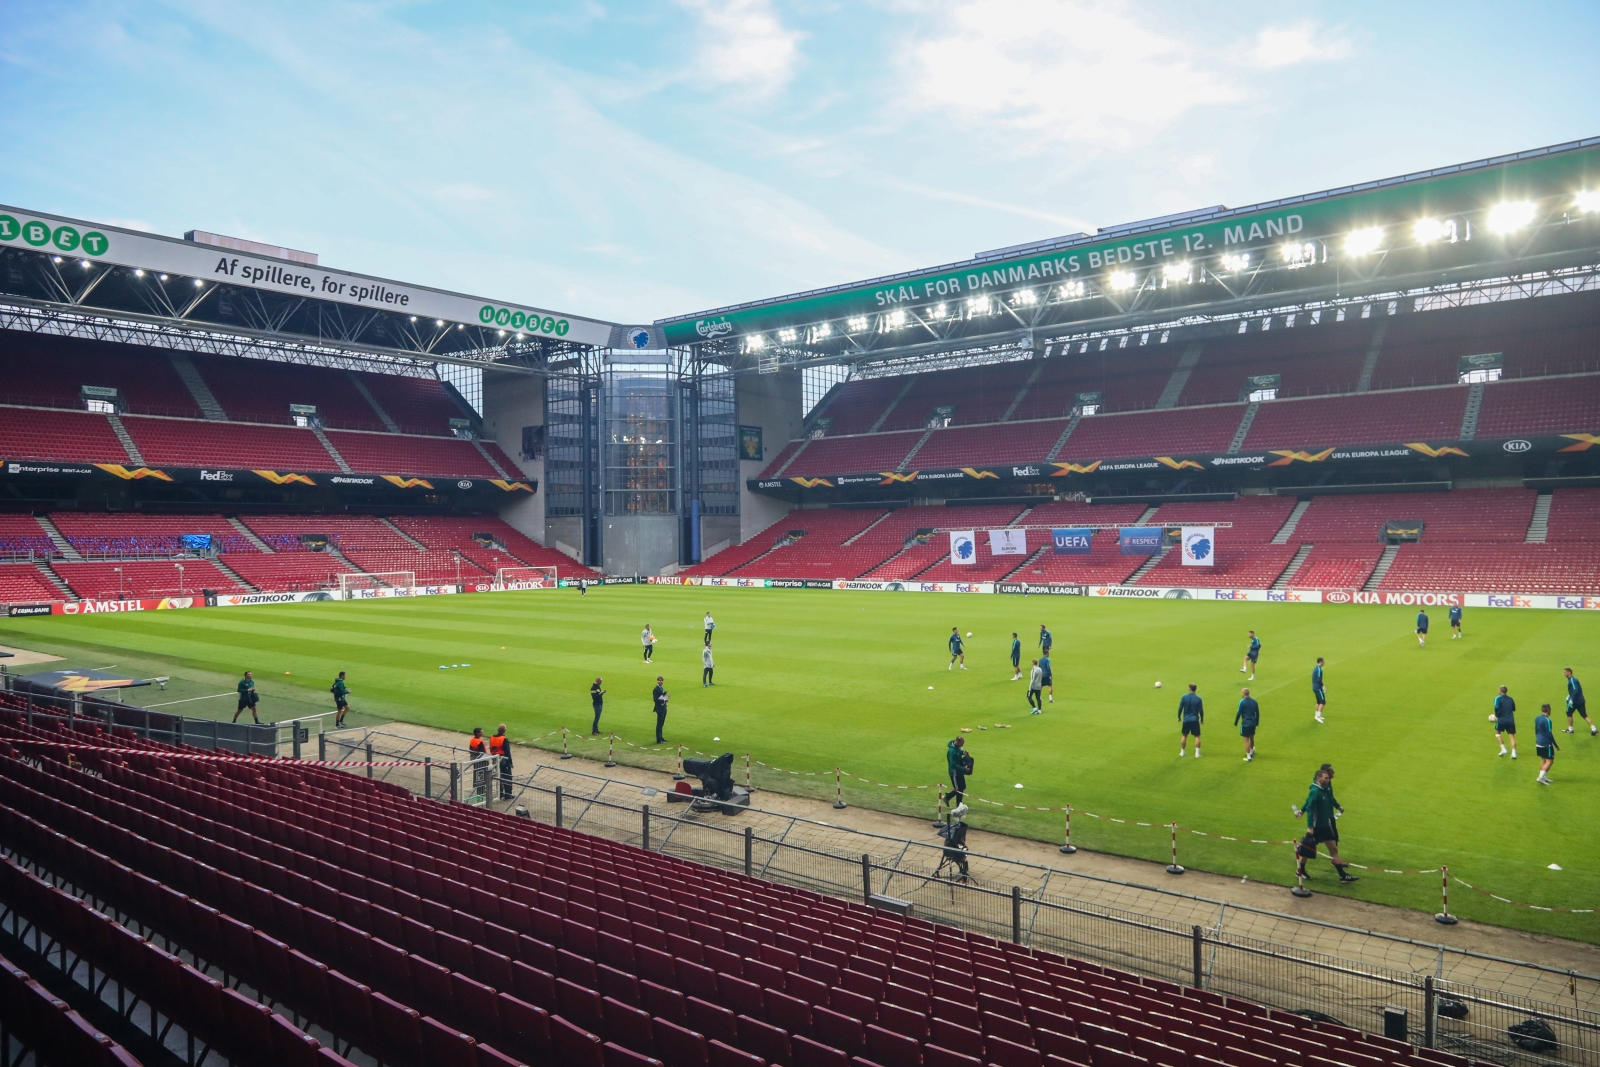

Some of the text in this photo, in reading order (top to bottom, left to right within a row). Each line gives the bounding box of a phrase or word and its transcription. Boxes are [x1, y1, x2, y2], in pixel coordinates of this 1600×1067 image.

[876, 214, 1304, 306] SKÅL FOR DANMARKS BEDSTE 12. MAND
[215, 257, 410, 306] Af spillere, for spillere
[481, 308, 569, 335] UNIBET
[1508, 442, 1527, 450] KIA
[201, 470, 233, 482] FedEx
[1013, 467, 1040, 477] FedEx
[1055, 537, 1089, 547] UEFA
[656, 576, 682, 585] AMSTEL
[711, 578, 729, 586] FedEx
[737, 579, 755, 587] FedEx
[425, 586, 449, 595] FedEx
[508, 581, 543, 591] MOTORS
[921, 583, 944, 592] FedEx
[956, 583, 980, 593] FedEx
[1051, 587, 1080, 595] LEAGUE
[361, 589, 387, 598] FedEx
[1215, 590, 1248, 600] FedEx
[1267, 591, 1302, 601] FedEx
[1329, 593, 1347, 601] KIA
[1353, 592, 1460, 606] KIA MOTORS
[1488, 595, 1532, 608] FedEx
[83, 600, 145, 614] AMSTEL
